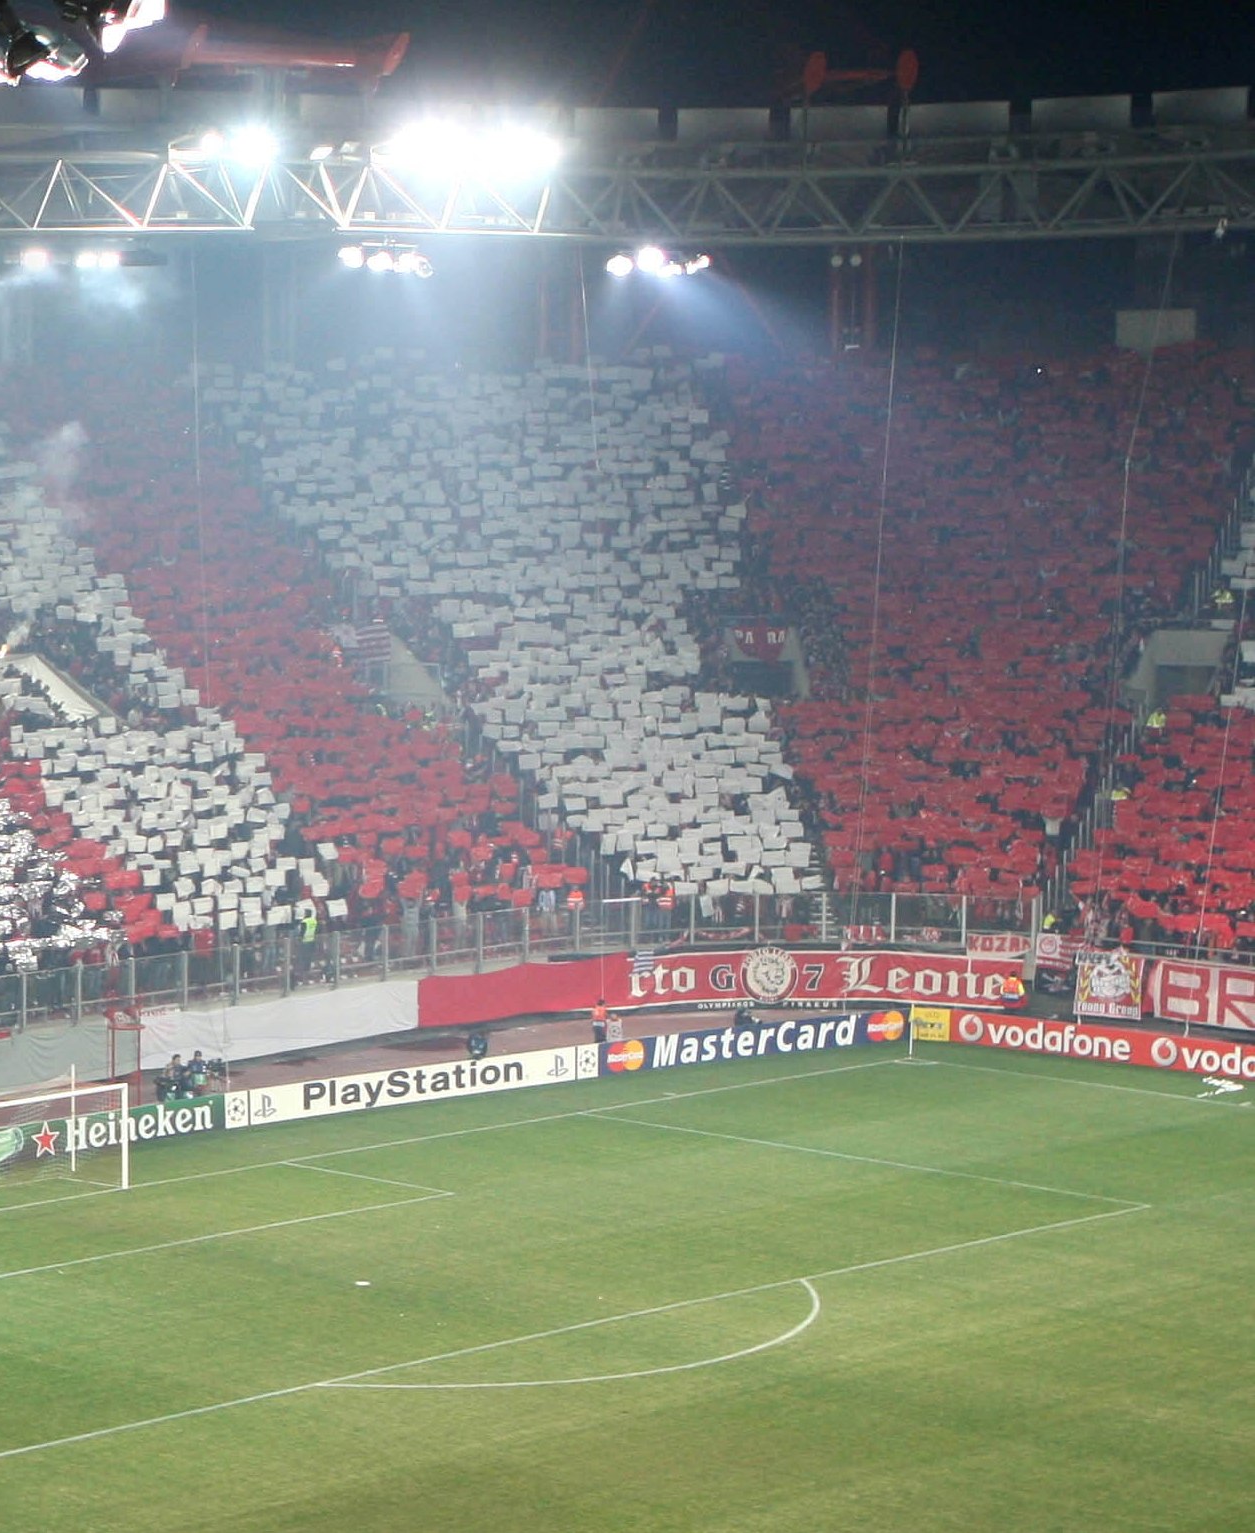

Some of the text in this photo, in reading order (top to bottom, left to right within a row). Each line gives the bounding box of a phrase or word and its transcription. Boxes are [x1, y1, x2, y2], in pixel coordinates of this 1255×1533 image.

[709, 964, 737, 991] G
[802, 963, 825, 991] 7
[837, 956, 1005, 1000] Leone
[652, 1015, 856, 1068] MasterCard
[988, 1022, 1131, 1060] vodafone
[302, 1061, 523, 1108] PlayStation
[65, 1104, 213, 1152] Heineken
